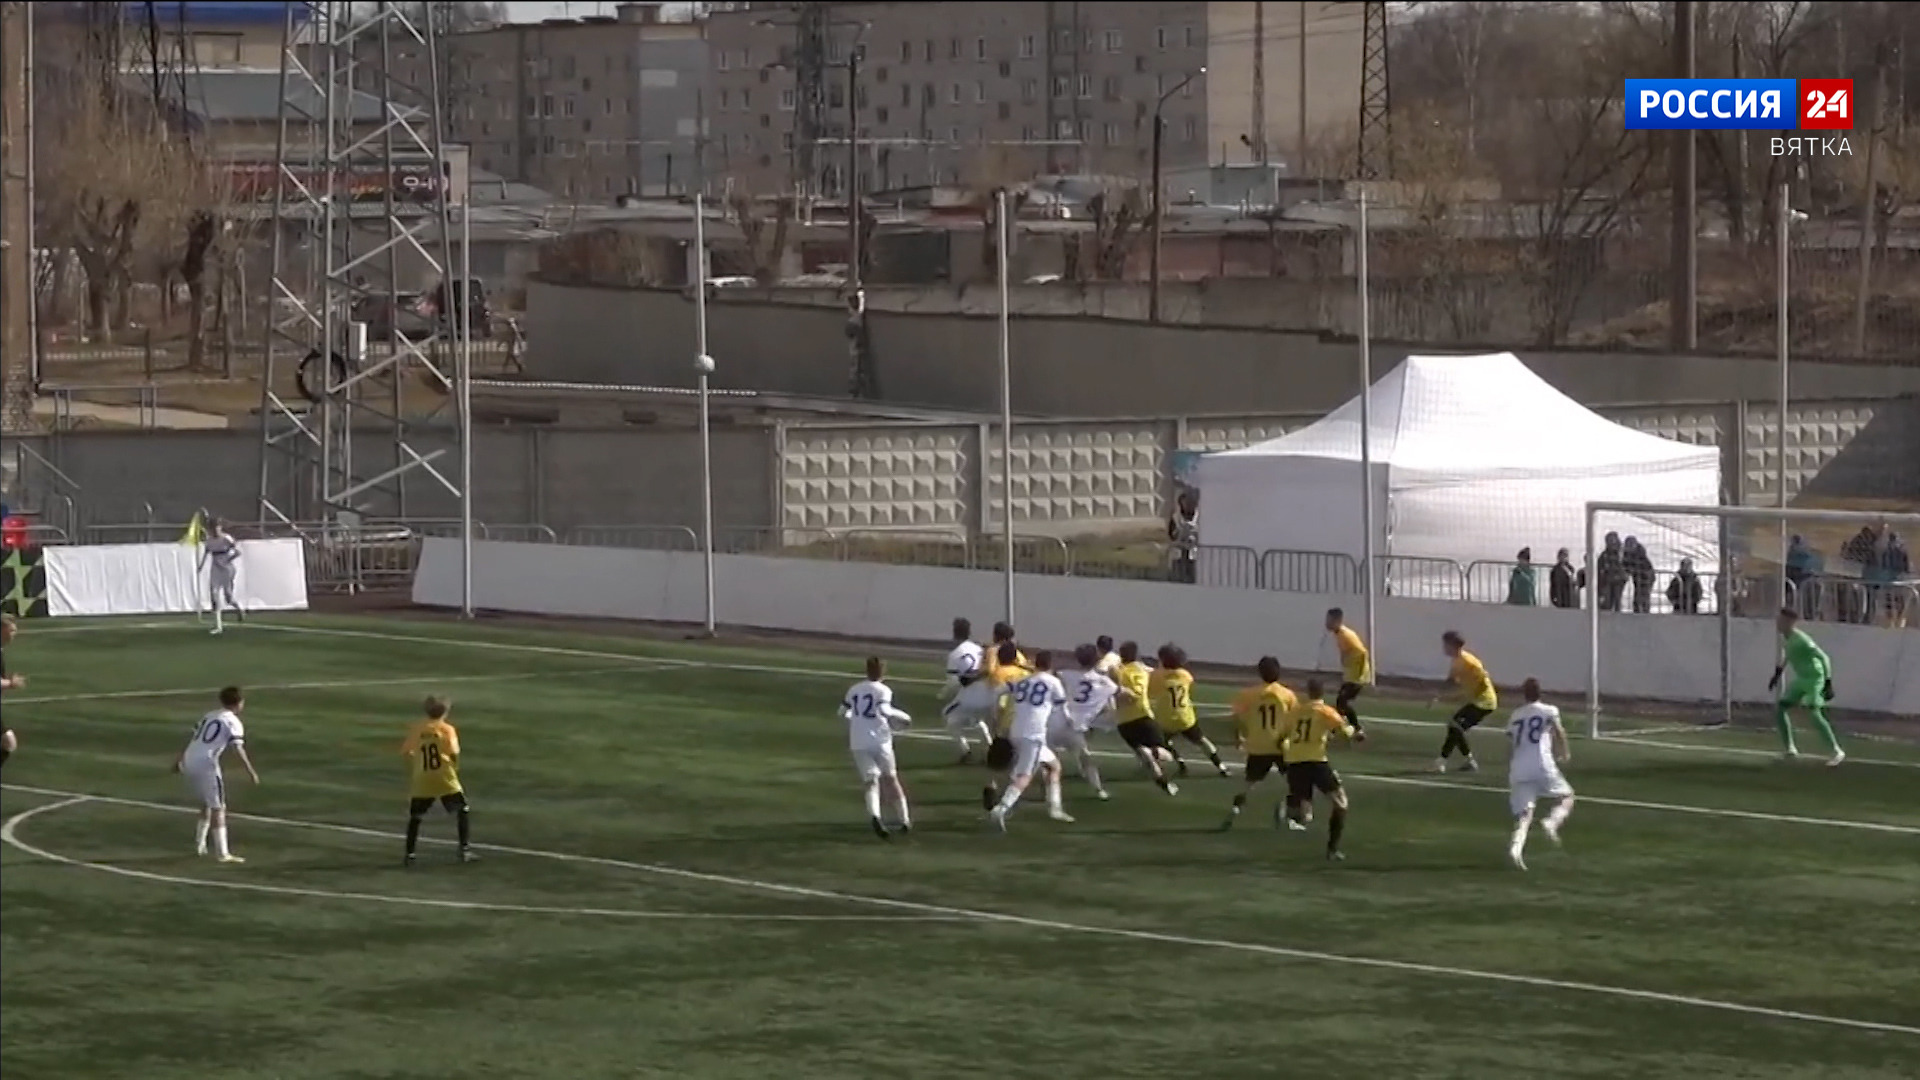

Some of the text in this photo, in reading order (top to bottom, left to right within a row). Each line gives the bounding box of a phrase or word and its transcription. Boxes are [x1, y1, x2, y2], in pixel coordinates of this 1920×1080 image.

[1073, 681, 1092, 703] 3
[1167, 685, 1187, 708] 12
[851, 693, 876, 719] 12
[1259, 703, 1276, 730] 11
[1512, 715, 1543, 746] 78
[421, 743, 441, 772] 18
